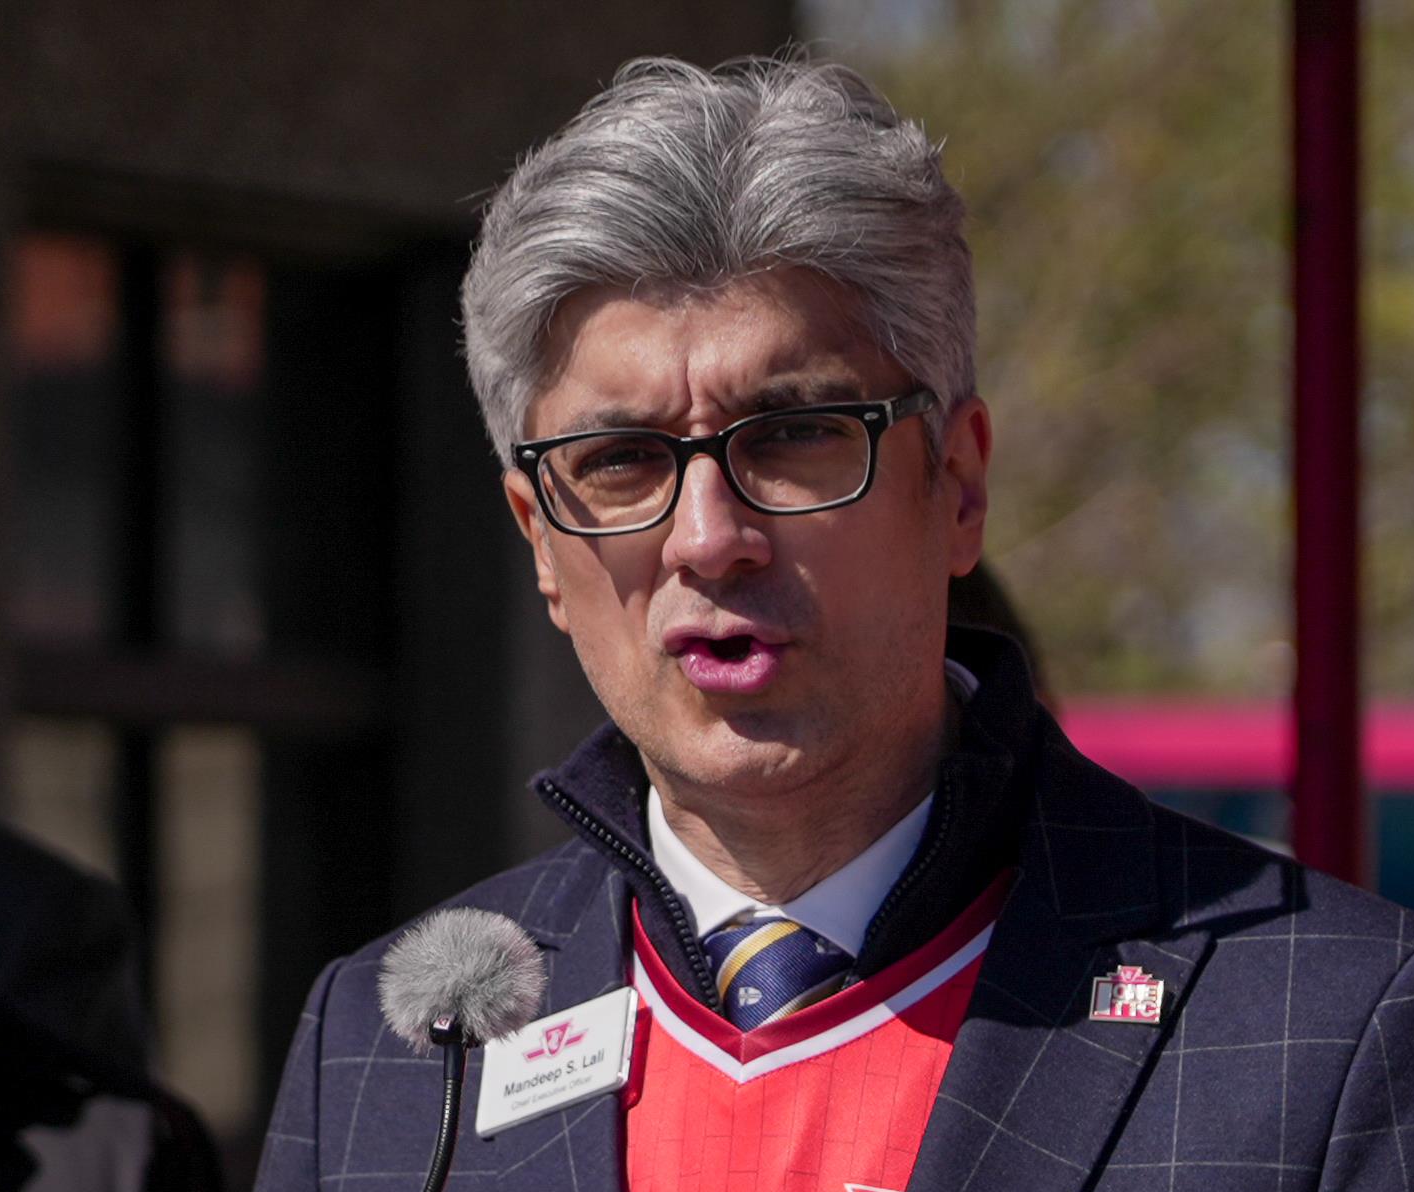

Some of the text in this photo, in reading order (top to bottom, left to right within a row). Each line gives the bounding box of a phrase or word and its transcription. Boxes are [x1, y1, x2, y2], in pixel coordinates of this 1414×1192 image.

[1112, 1000, 1157, 1017] TTC
[503, 1067, 562, 1097] Mandeep
[566, 1060, 578, 1074] S.
